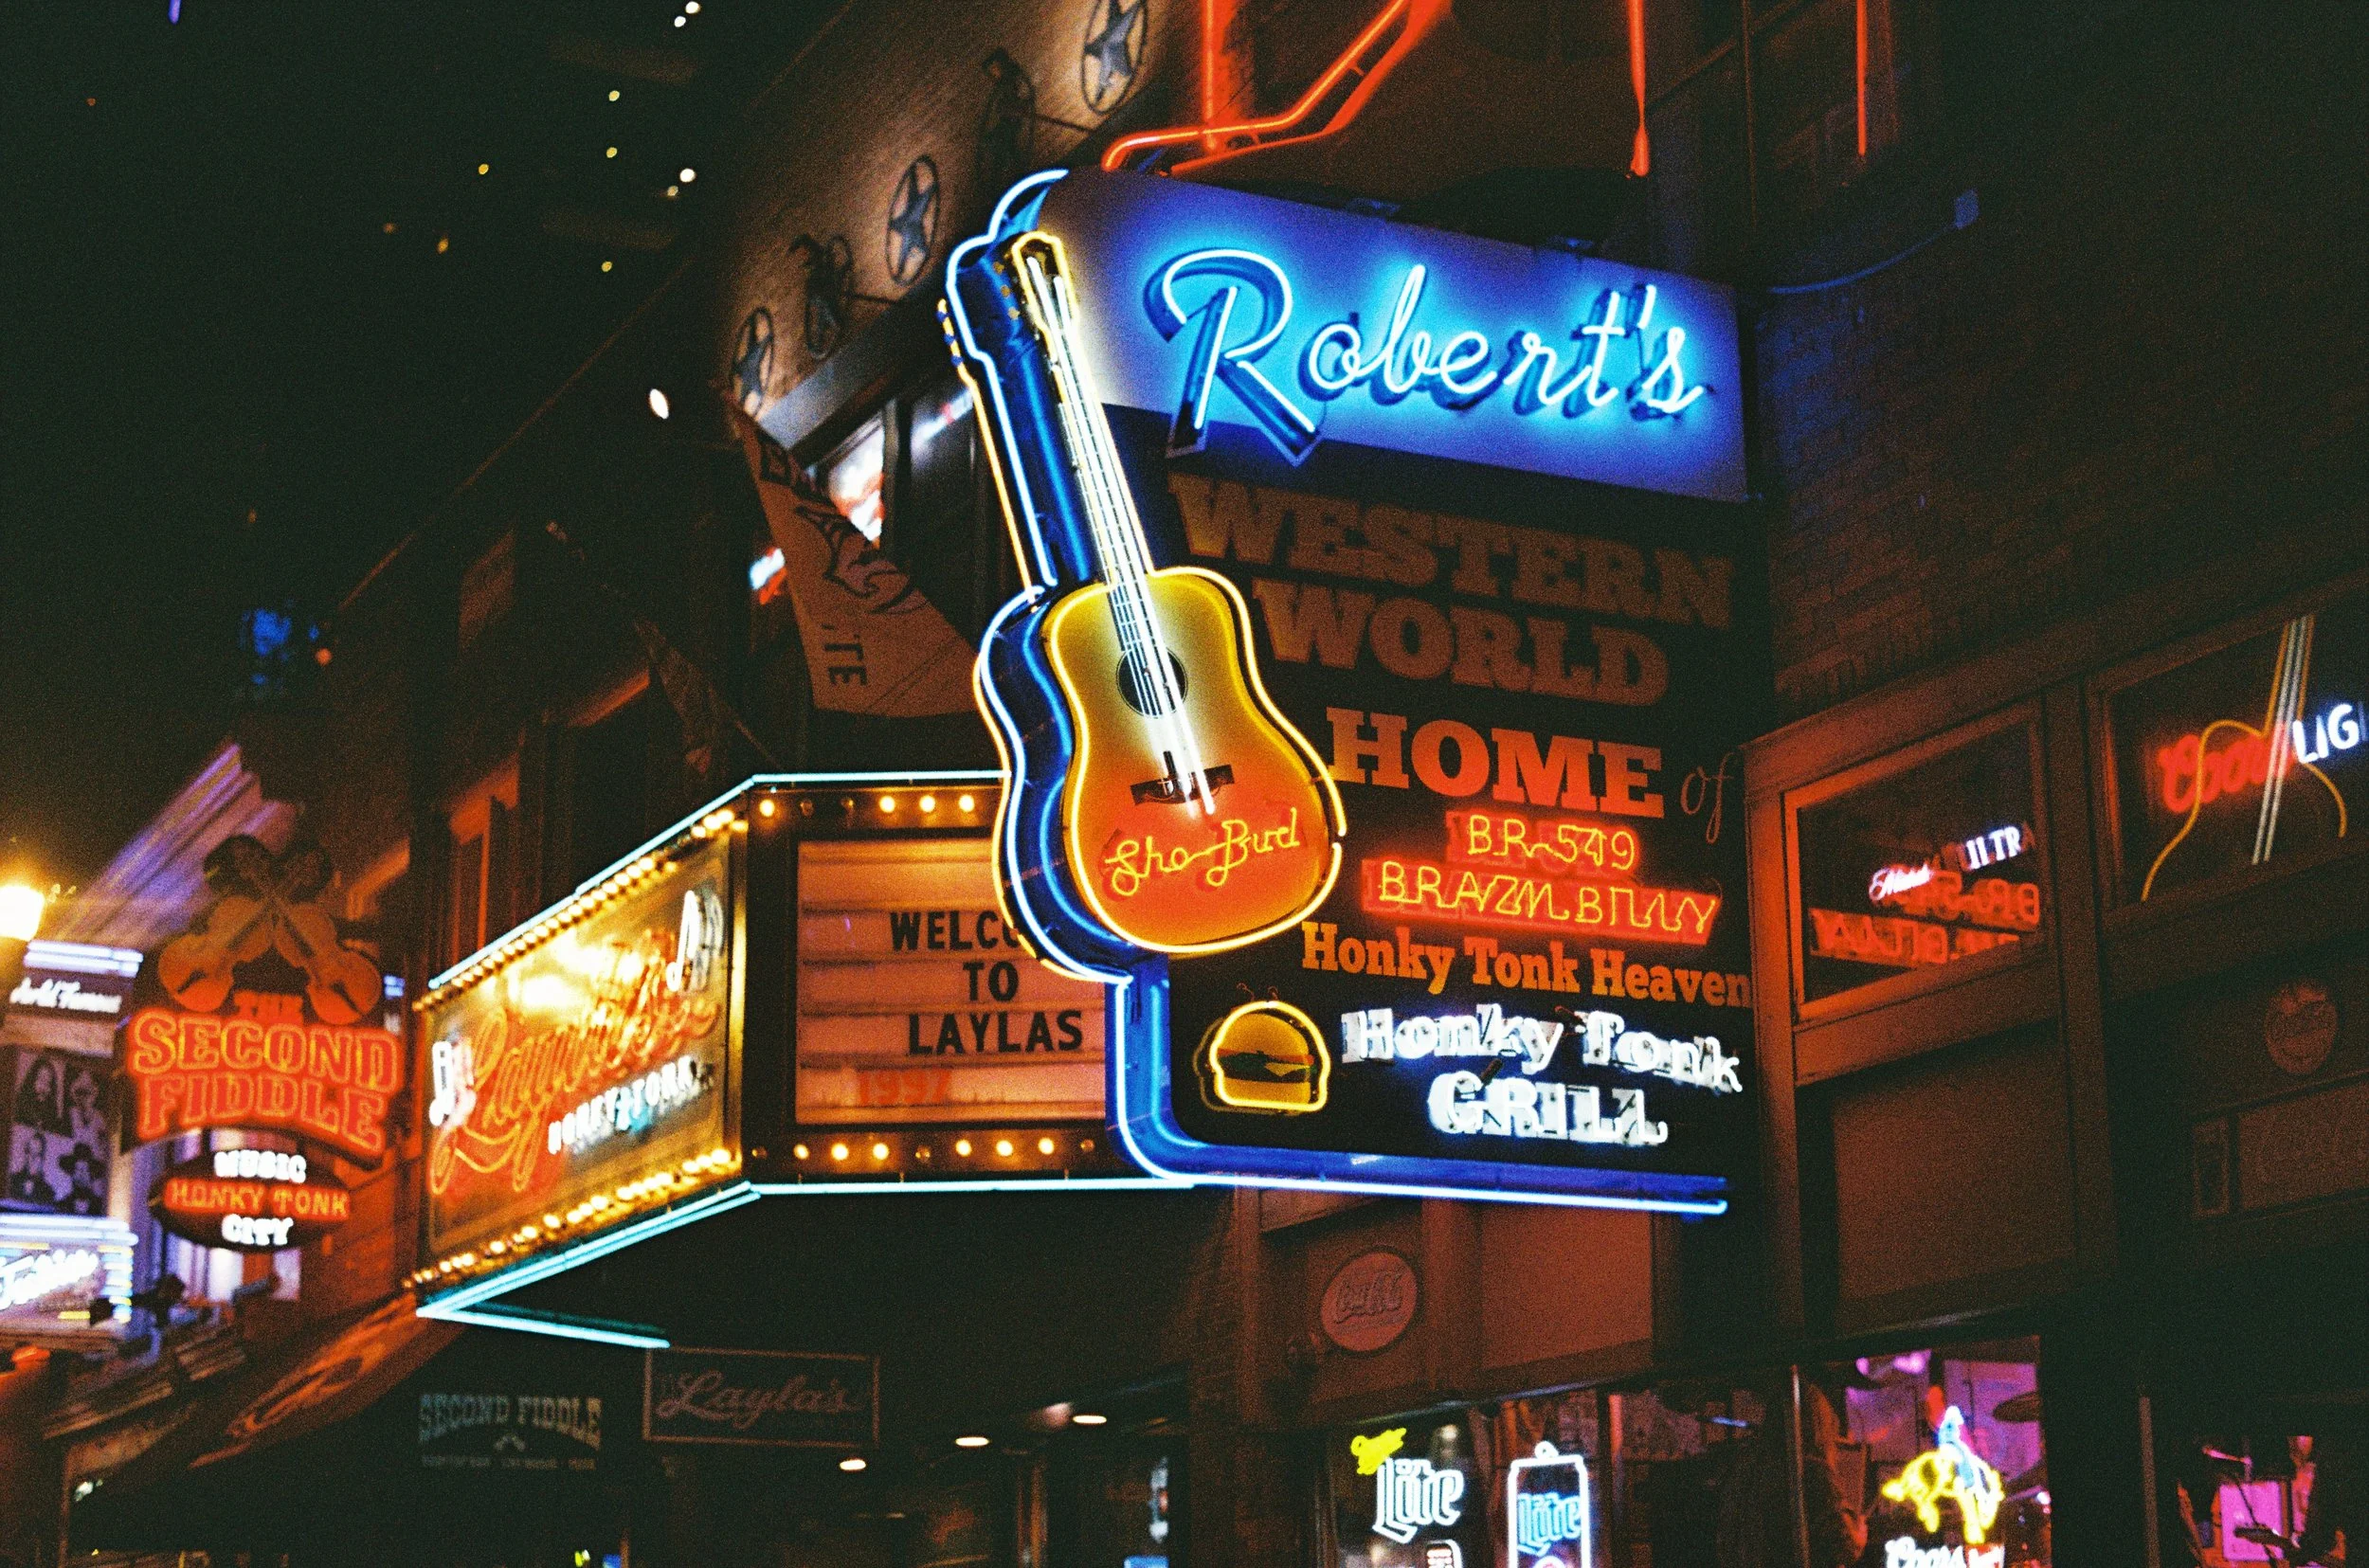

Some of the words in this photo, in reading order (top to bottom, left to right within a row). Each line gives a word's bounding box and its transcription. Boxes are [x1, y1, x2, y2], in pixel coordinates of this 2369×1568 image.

[1144, 246, 1713, 466] Robert's
[1168, 475, 1733, 630] WESTERN
[1251, 576, 1671, 706] WORLD
[2292, 701, 2368, 765] LIG
[1326, 707, 1664, 819] HOME
[1679, 751, 1736, 844] of
[963, 960, 1020, 1002] TO
[1302, 920, 1456, 995] Honky
[1464, 938, 1581, 993] Tonk
[1591, 946, 1751, 1009] Heaven
[233, 990, 305, 1023] THE
[909, 1009, 1084, 1054] LAYLAS
[131, 1009, 400, 1095] SECOND
[1340, 1001, 1564, 1073] Honky
[1575, 1007, 1744, 1094] Tonk
[138, 1072, 388, 1153] FIDDLE
[1428, 1072, 1669, 1145] GRILL
[168, 1179, 265, 1215] HONKY
[271, 1186, 352, 1220] TONK
[214, 1149, 307, 1183] MUSIC
[221, 1213, 294, 1246] CITY
[419, 1393, 510, 1445] SECOND
[516, 1395, 604, 1452] FIDDLE
[654, 1367, 867, 1431] Layla's
[1371, 1456, 1465, 1544] Lite
[1517, 1491, 1582, 1557] Lite
